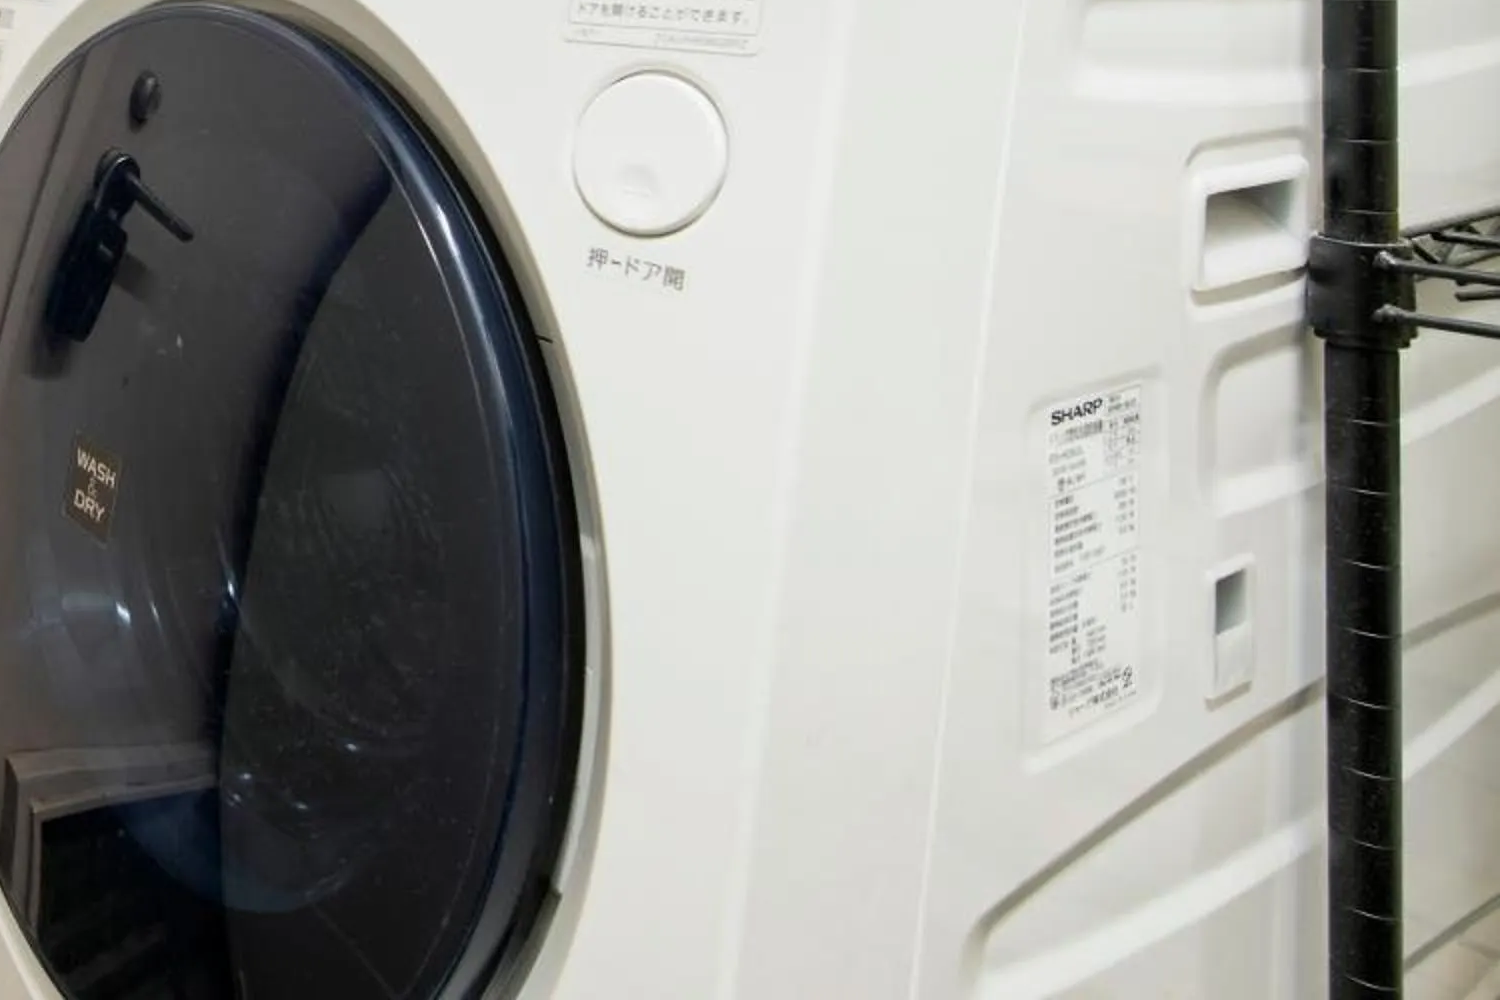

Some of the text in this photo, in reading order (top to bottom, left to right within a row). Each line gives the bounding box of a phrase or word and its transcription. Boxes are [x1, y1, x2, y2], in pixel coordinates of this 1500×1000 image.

[1050, 397, 1103, 427] SHARP
[77, 446, 117, 490] WASH
[73, 487, 105, 522] DRY
